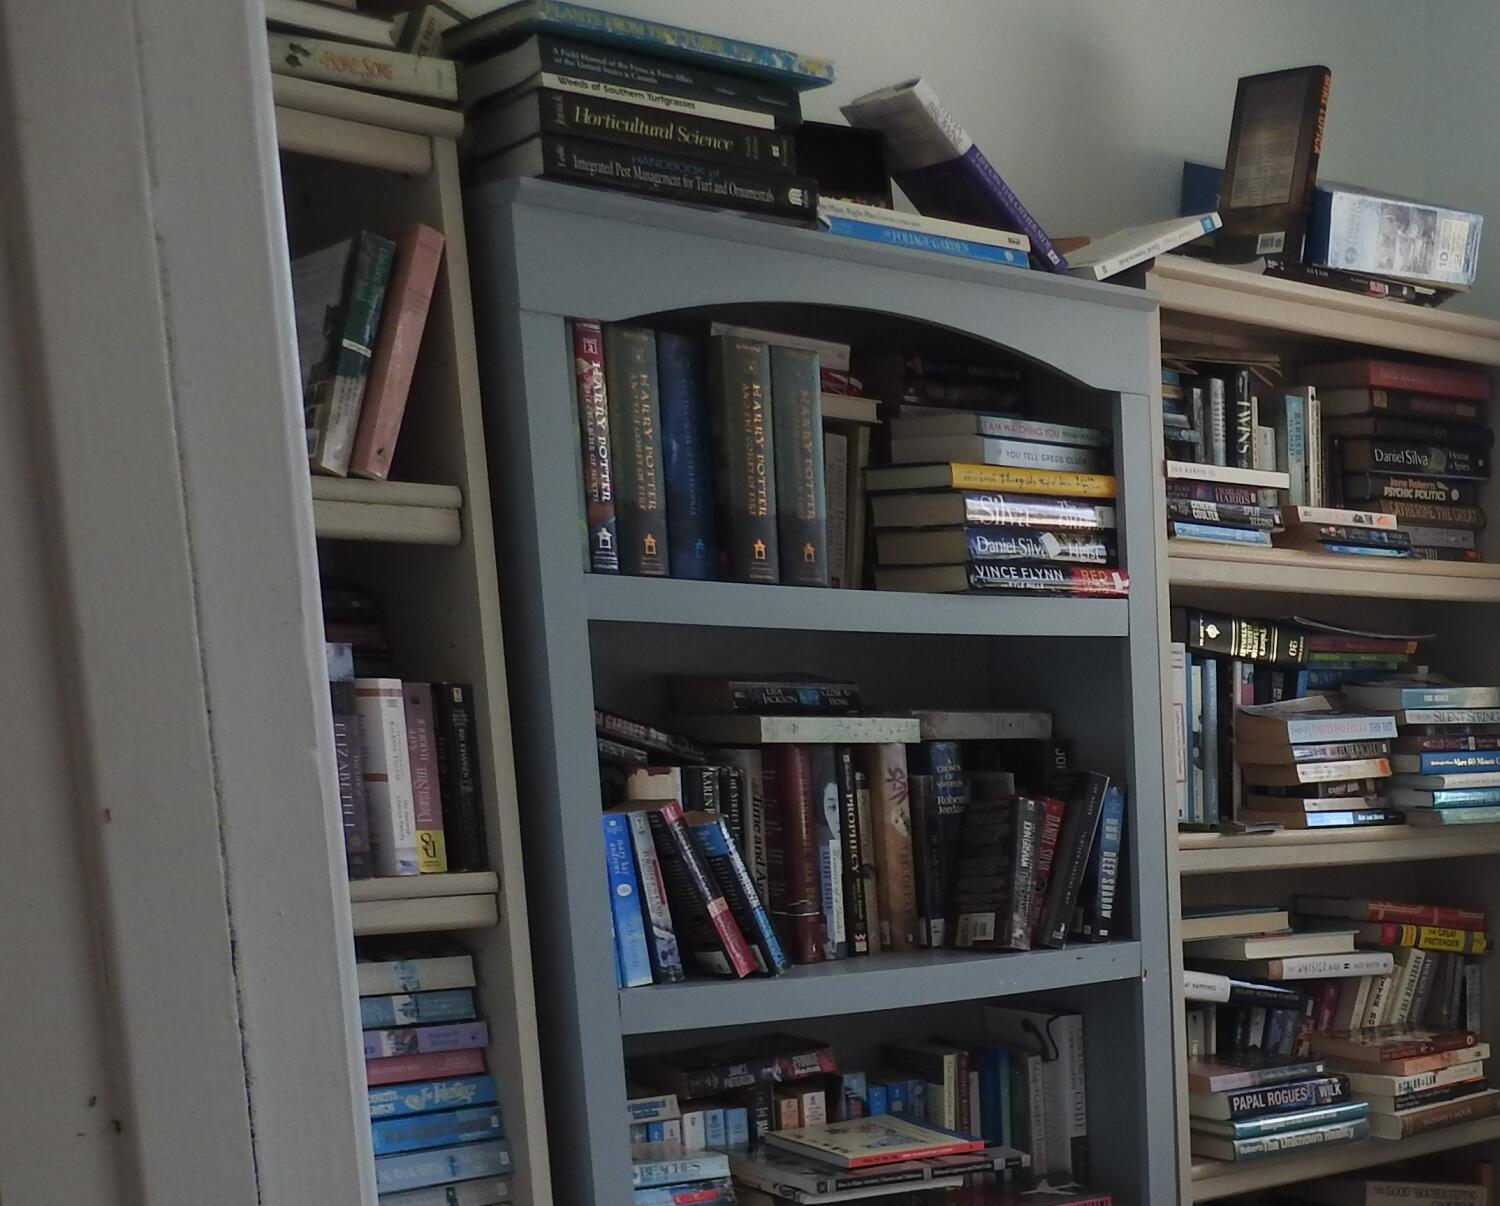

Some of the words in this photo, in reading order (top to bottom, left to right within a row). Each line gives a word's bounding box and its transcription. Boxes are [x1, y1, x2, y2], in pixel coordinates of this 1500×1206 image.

[558, 76, 590, 91] Weeds
[592, 80, 601, 91] of
[604, 85, 645, 101] Southern
[646, 91, 696, 111] Turfgrasses
[574, 105, 674, 141] Horticultural
[677, 126, 735, 151] Science
[572, 154, 614, 177] Integrated
[615, 160, 632, 178] Pest
[633, 165, 682, 188] Management
[683, 175, 696, 190] for
[697, 178, 714, 193] Turf
[714, 182, 728, 196] and
[728, 182, 776, 203] Ornamentals
[592, 360, 608, 431] HARRY
[639, 373, 654, 441] HARRY
[751, 383, 766, 452] HARRY
[800, 390, 814, 454] HARRY
[988, 422, 1002, 433] AM
[1003, 423, 1043, 438] WATCHING
[1044, 427, 1061, 439] YOU
[596, 435, 613, 503] POTTER
[1005, 450, 1022, 461] YOU
[1023, 452, 1040, 463] TELL
[1374, 448, 1405, 465] Daniel
[1405, 449, 1429, 466] Silva
[643, 447, 658, 511] POTTER
[755, 453, 768, 518] POTTER
[803, 461, 817, 521] POTTER
[1383, 486, 1414, 500] PSYCHIC
[1414, 488, 1447, 502] POLITICS
[978, 494, 1032, 528] Silva
[976, 535, 1018, 556] Daniel
[1018, 537, 1049, 558] Silva
[973, 564, 1019, 580] VINCE
[1021, 567, 1065, 582] FLYNN
[1080, 568, 1108, 582] RED
[1433, 709, 1465, 724] SILENT
[1466, 710, 1500, 723] SPRING
[335, 723, 355, 815] ELIZABETH
[702, 771, 715, 807] KAREN
[752, 796, 763, 834] Time
[1043, 814, 1061, 845] DANIEL
[845, 793, 860, 873] PROPHECY
[754, 836, 766, 866] and
[1102, 851, 1118, 875] DEEP
[1100, 877, 1117, 919] SHADOW
[1423, 937, 1460, 947] PRETENDER
[1437, 928, 1457, 939] GREAT
[1232, 1093, 1266, 1112] PAPAL
[1267, 1086, 1308, 1106] ROGUES
[1318, 1082, 1343, 1099] WILK
[1385, 1186, 1410, 1198] GOOD
[1413, 1187, 1478, 1200] HOUSEKEEPING
